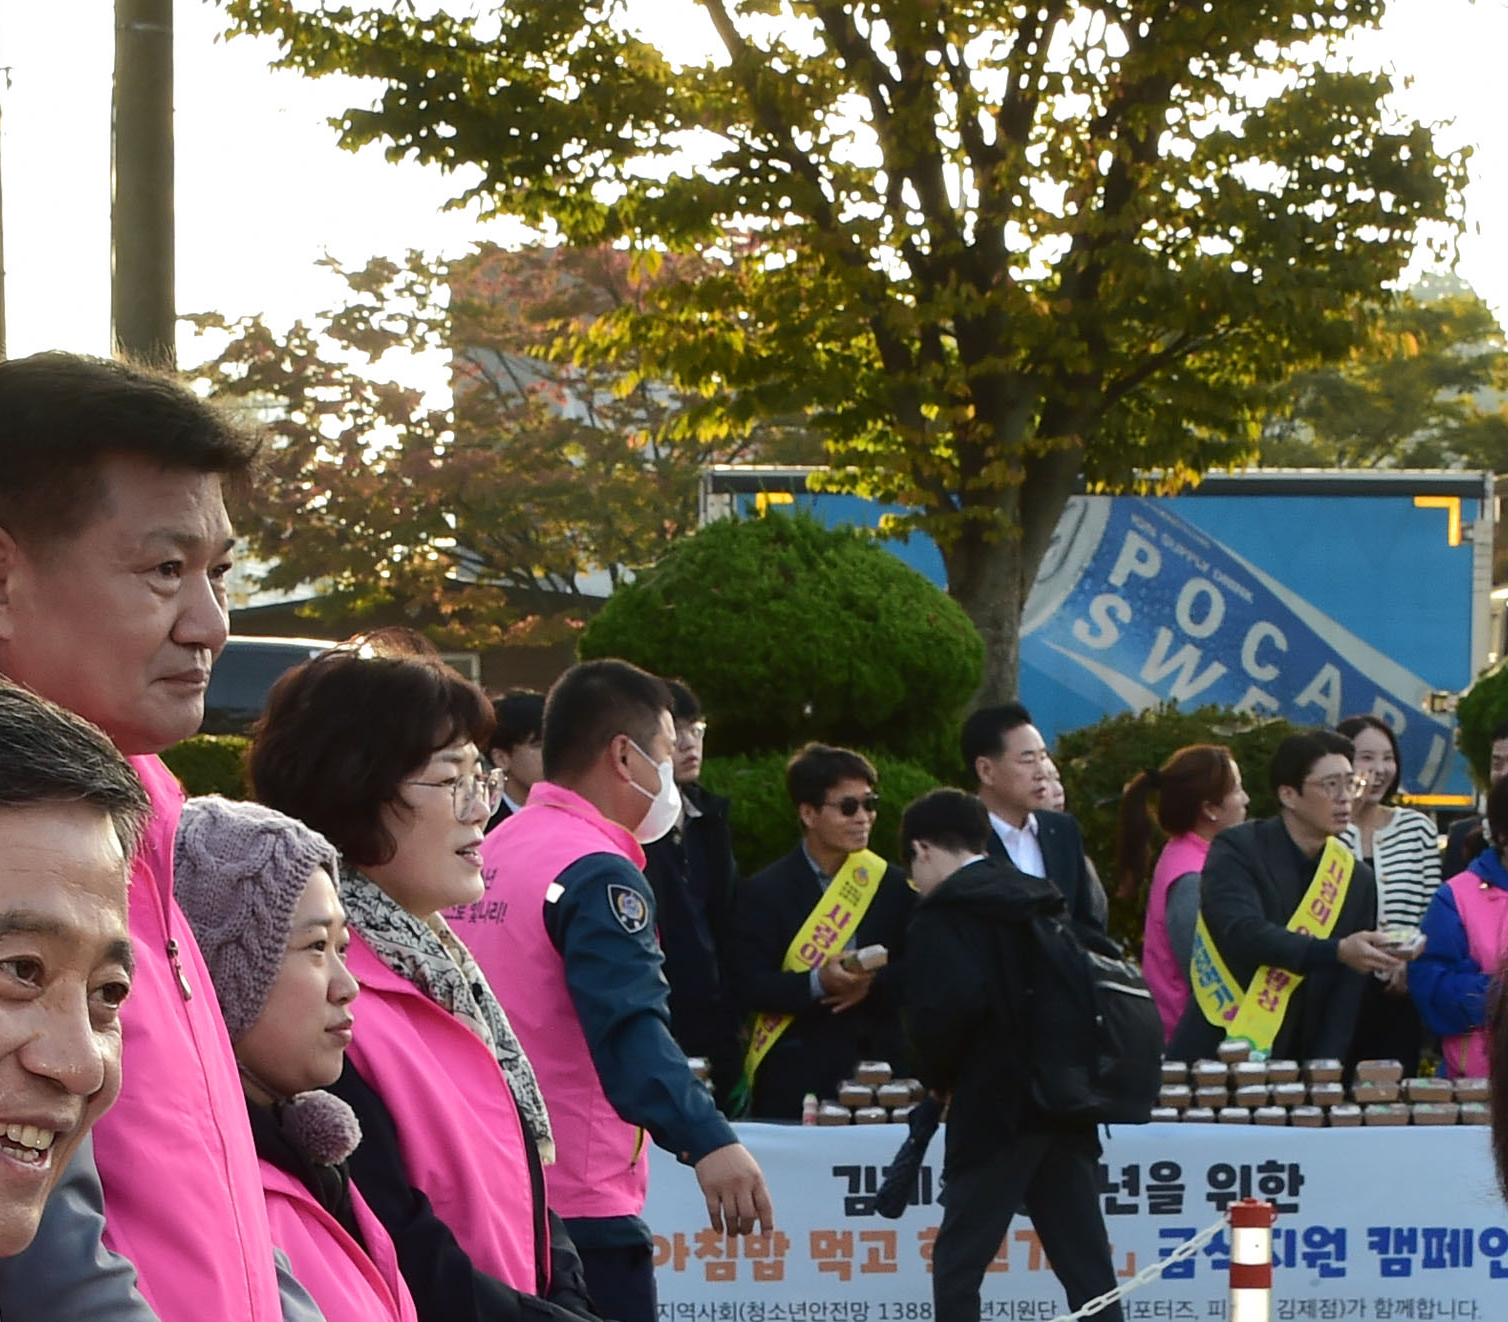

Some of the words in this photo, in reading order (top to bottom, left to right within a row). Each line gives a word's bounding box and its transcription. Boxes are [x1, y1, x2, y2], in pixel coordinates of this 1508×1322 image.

[1206, 1160, 1305, 1214] 위한
[810, 1230, 898, 1281] 먹고
[1277, 1298, 1367, 1320] 김제점)가
[1374, 1298, 1483, 1321] 함께합니다.
